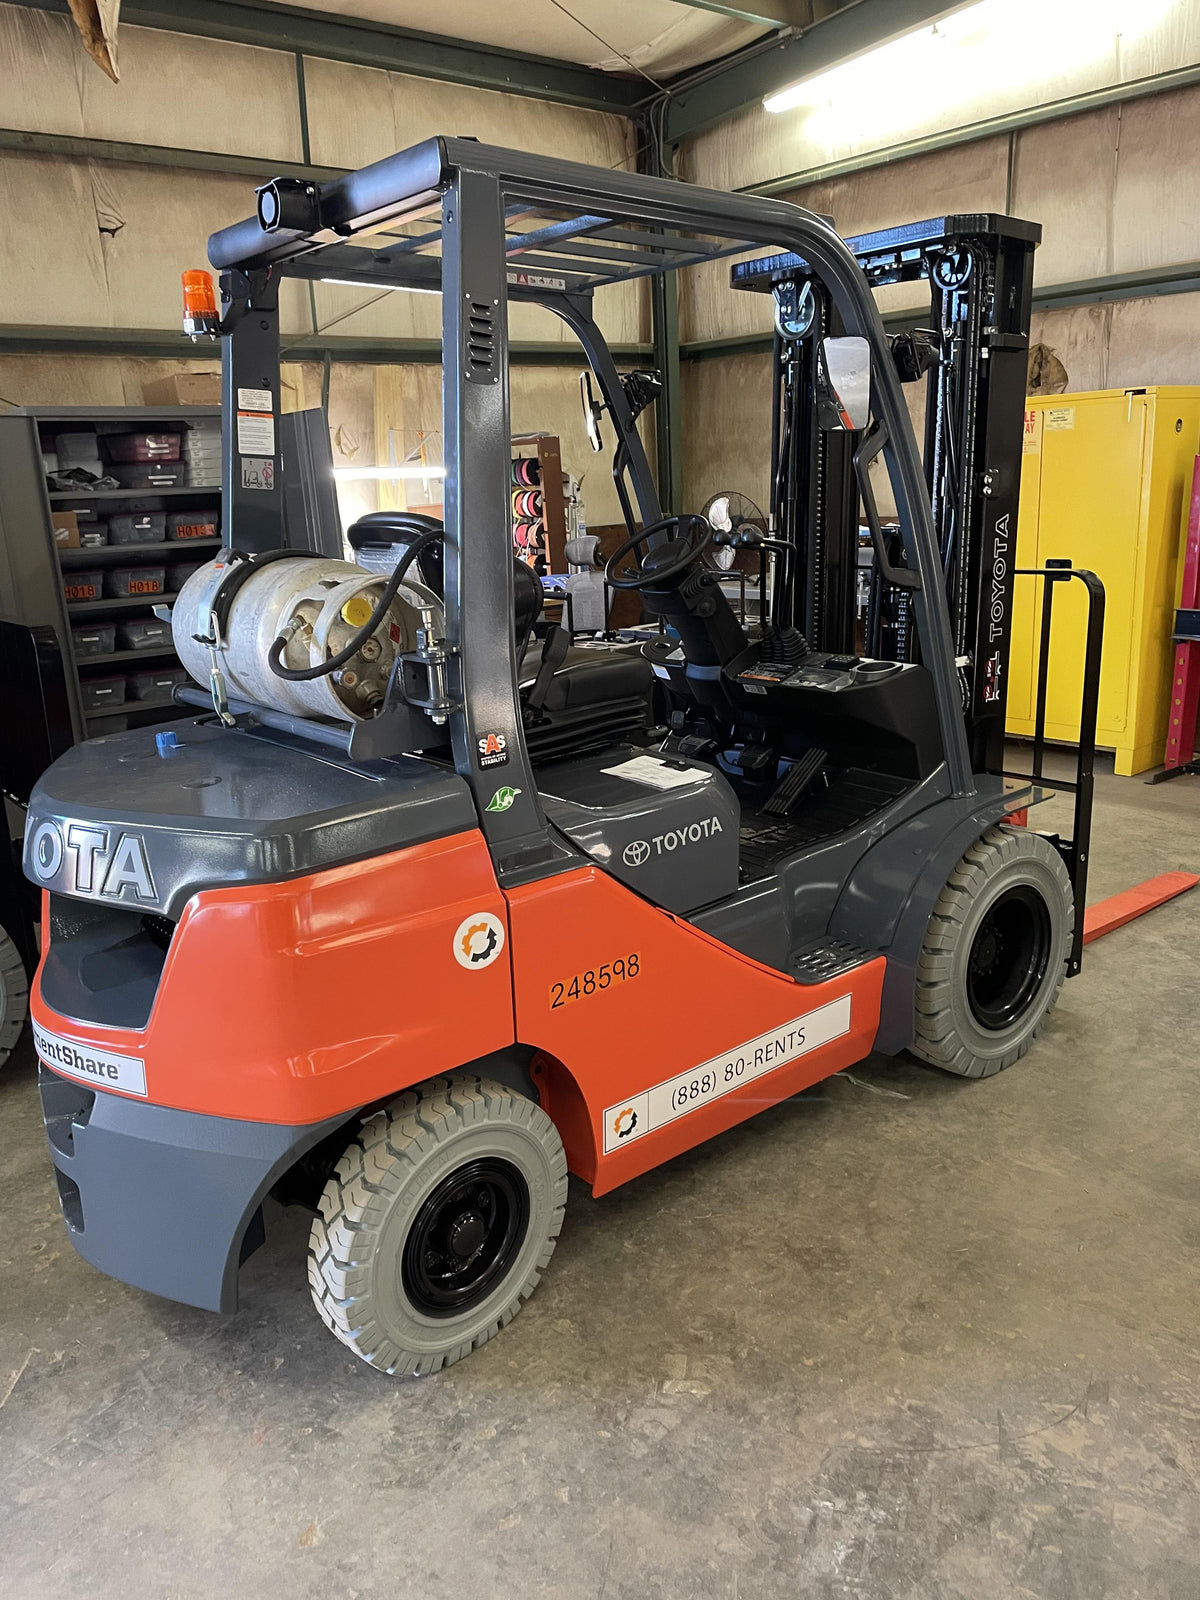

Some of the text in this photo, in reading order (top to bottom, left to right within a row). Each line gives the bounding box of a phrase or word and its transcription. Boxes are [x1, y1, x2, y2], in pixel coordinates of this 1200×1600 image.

[128, 580, 161, 594] H018
[989, 513, 1010, 643] TOYOTA
[478, 733, 507, 755] SAS
[480, 755, 507, 767] STABILITY
[652, 816, 723, 855] TOYOTA
[550, 953, 641, 1010] 248598
[671, 1027, 806, 1111] (888) 80-RENTS
